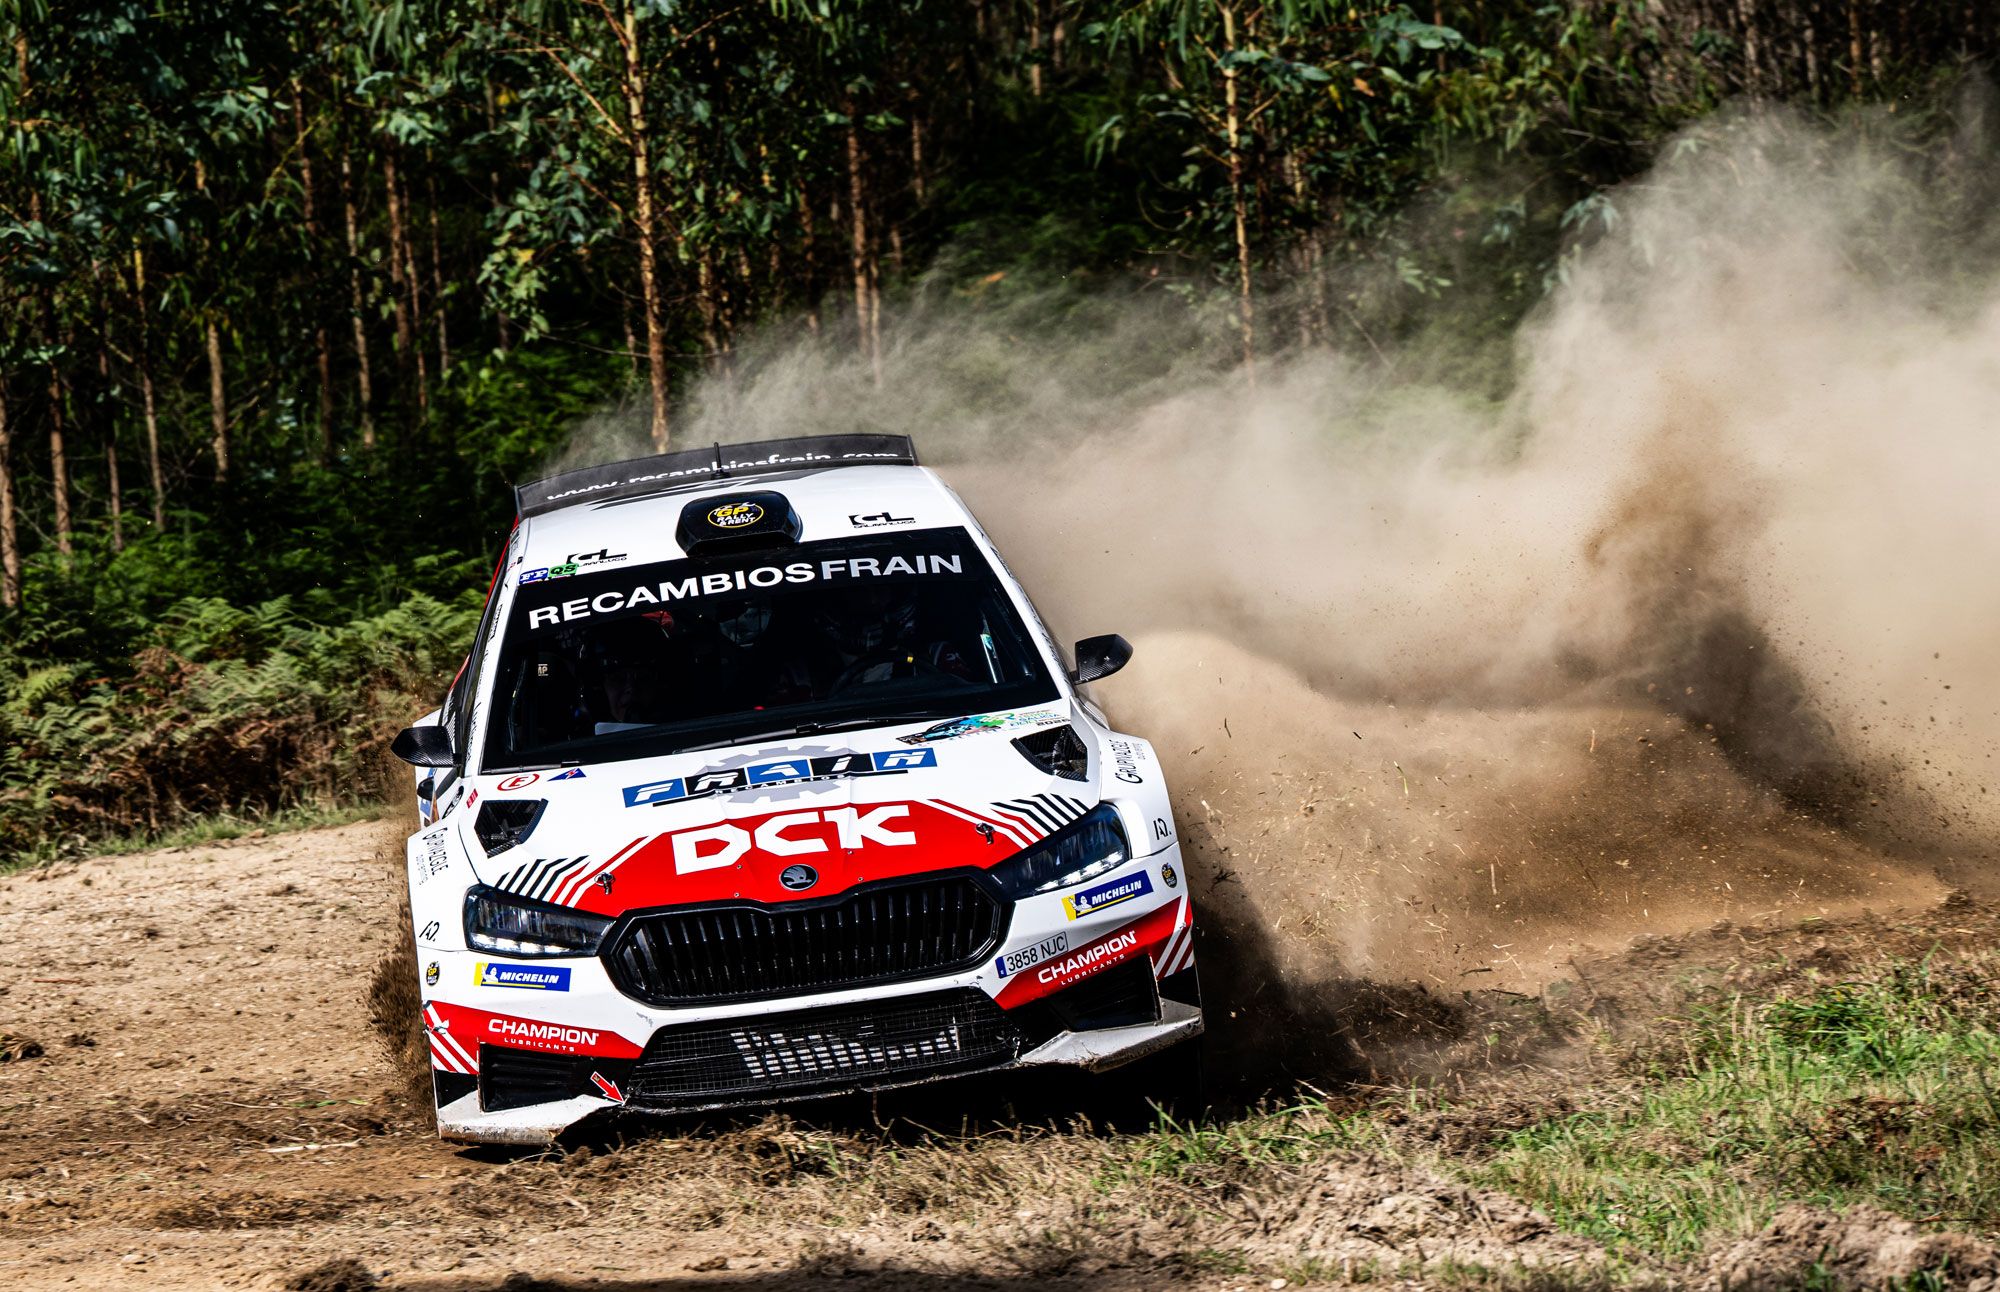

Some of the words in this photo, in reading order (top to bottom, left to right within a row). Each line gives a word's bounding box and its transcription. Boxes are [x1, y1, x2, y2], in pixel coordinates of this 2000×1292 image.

[717, 507, 749, 517] GP
[550, 564, 576, 575] QS
[671, 804, 917, 875] DCK
[1091, 880, 1142, 905] MICHELIN
[1006, 947, 1038, 972] 3858
[1040, 936, 1066, 958] NJC
[1038, 931, 1137, 983] CHAMPION
[500, 971, 560, 984] MICHELIN
[1061, 953, 1125, 985] LUBRICANTS
[488, 1018, 597, 1046] CHAMPION
[504, 1038, 575, 1052] LUBRICANTS
